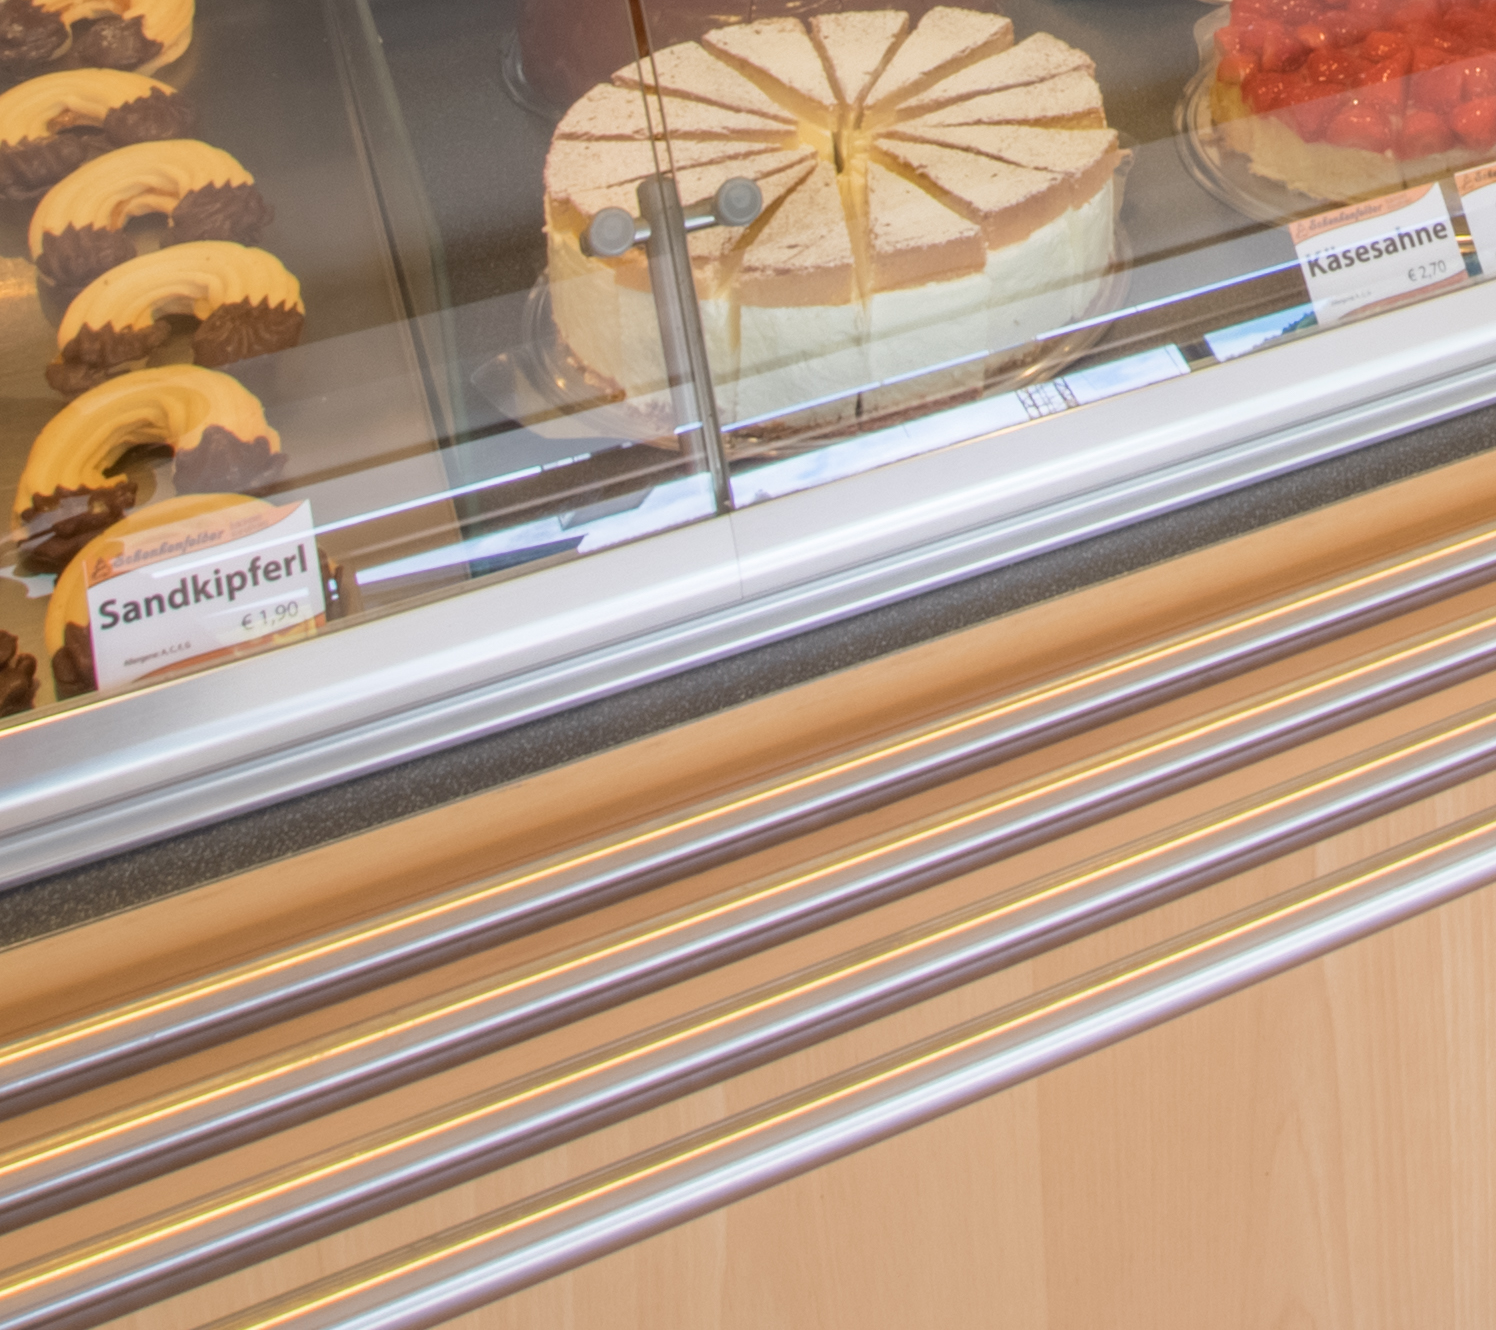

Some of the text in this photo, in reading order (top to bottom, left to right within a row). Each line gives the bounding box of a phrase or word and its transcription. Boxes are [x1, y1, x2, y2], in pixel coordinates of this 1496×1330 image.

[1306, 220, 1449, 279] Käsesahne
[1418, 259, 1447, 280] 2,70
[99, 543, 309, 631] Sandkipferl
[241, 600, 299, 630] € 1,90
